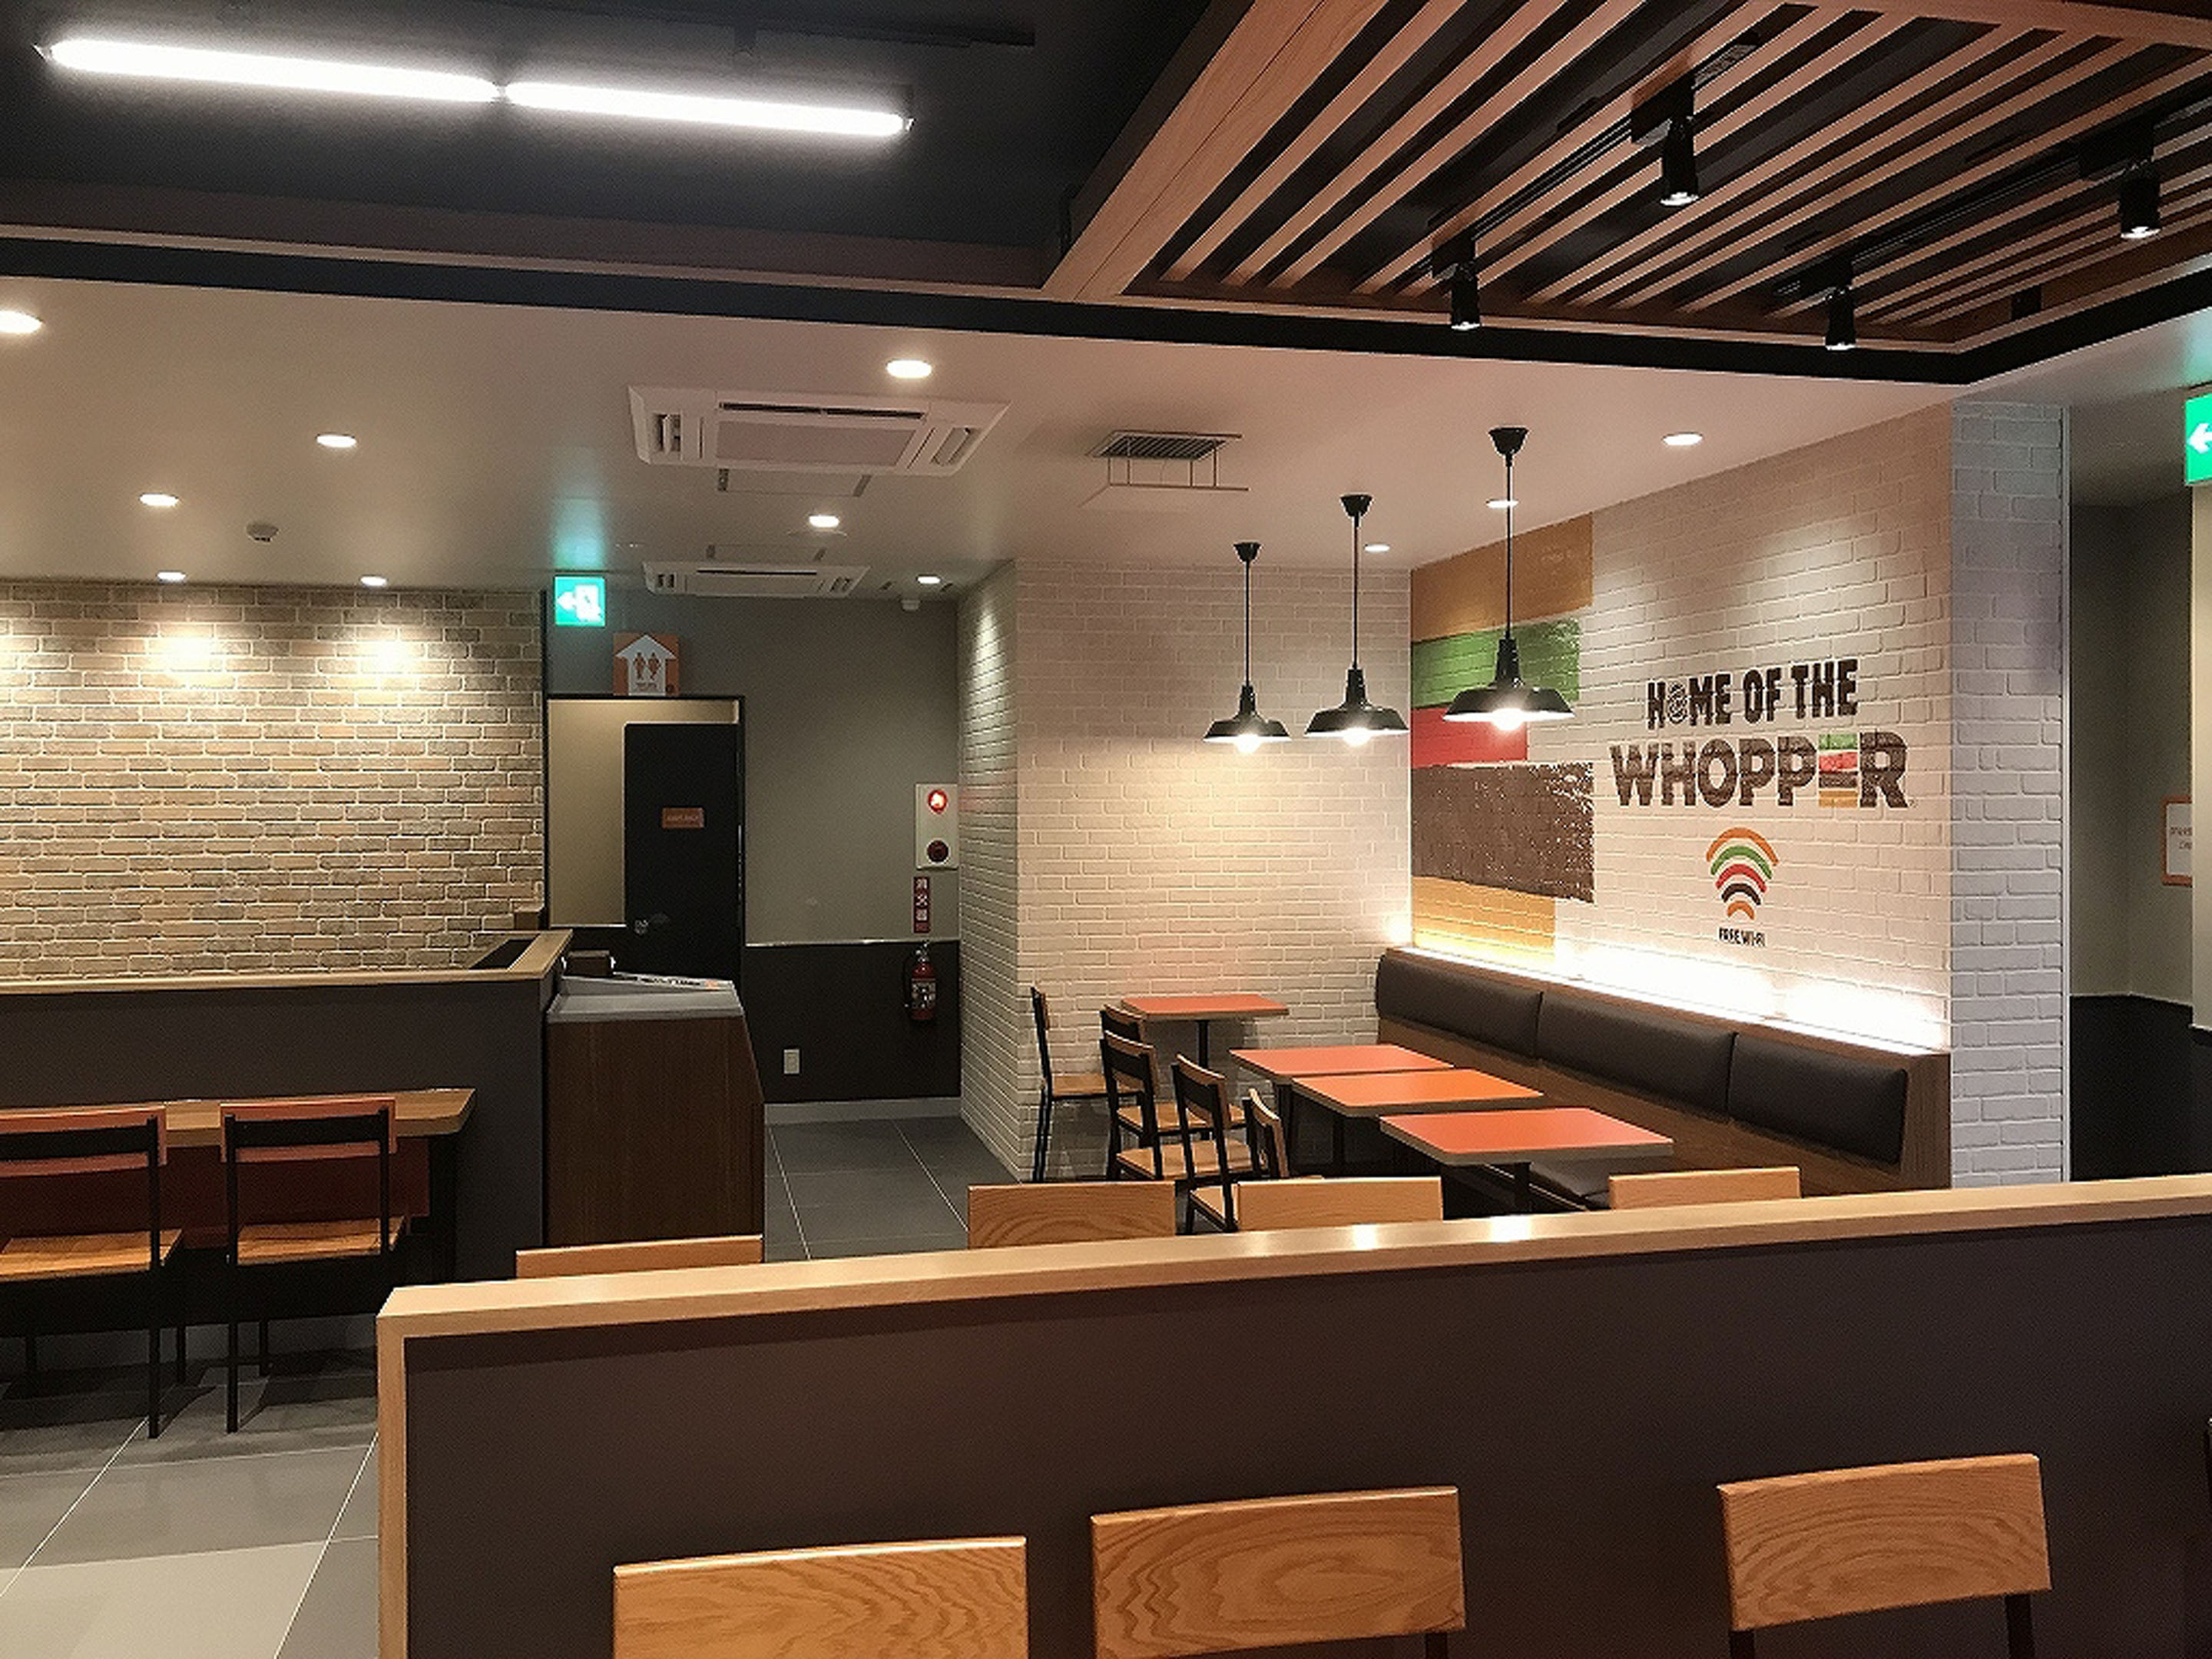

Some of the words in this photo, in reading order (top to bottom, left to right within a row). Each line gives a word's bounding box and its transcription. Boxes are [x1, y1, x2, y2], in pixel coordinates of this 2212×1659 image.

[1647, 673, 1732, 730] HOME
[1742, 667, 1781, 724] OF
[1790, 658, 1859, 719] THE
[1608, 731, 1909, 809] WHOPPER
[1718, 927, 1740, 945] FREE
